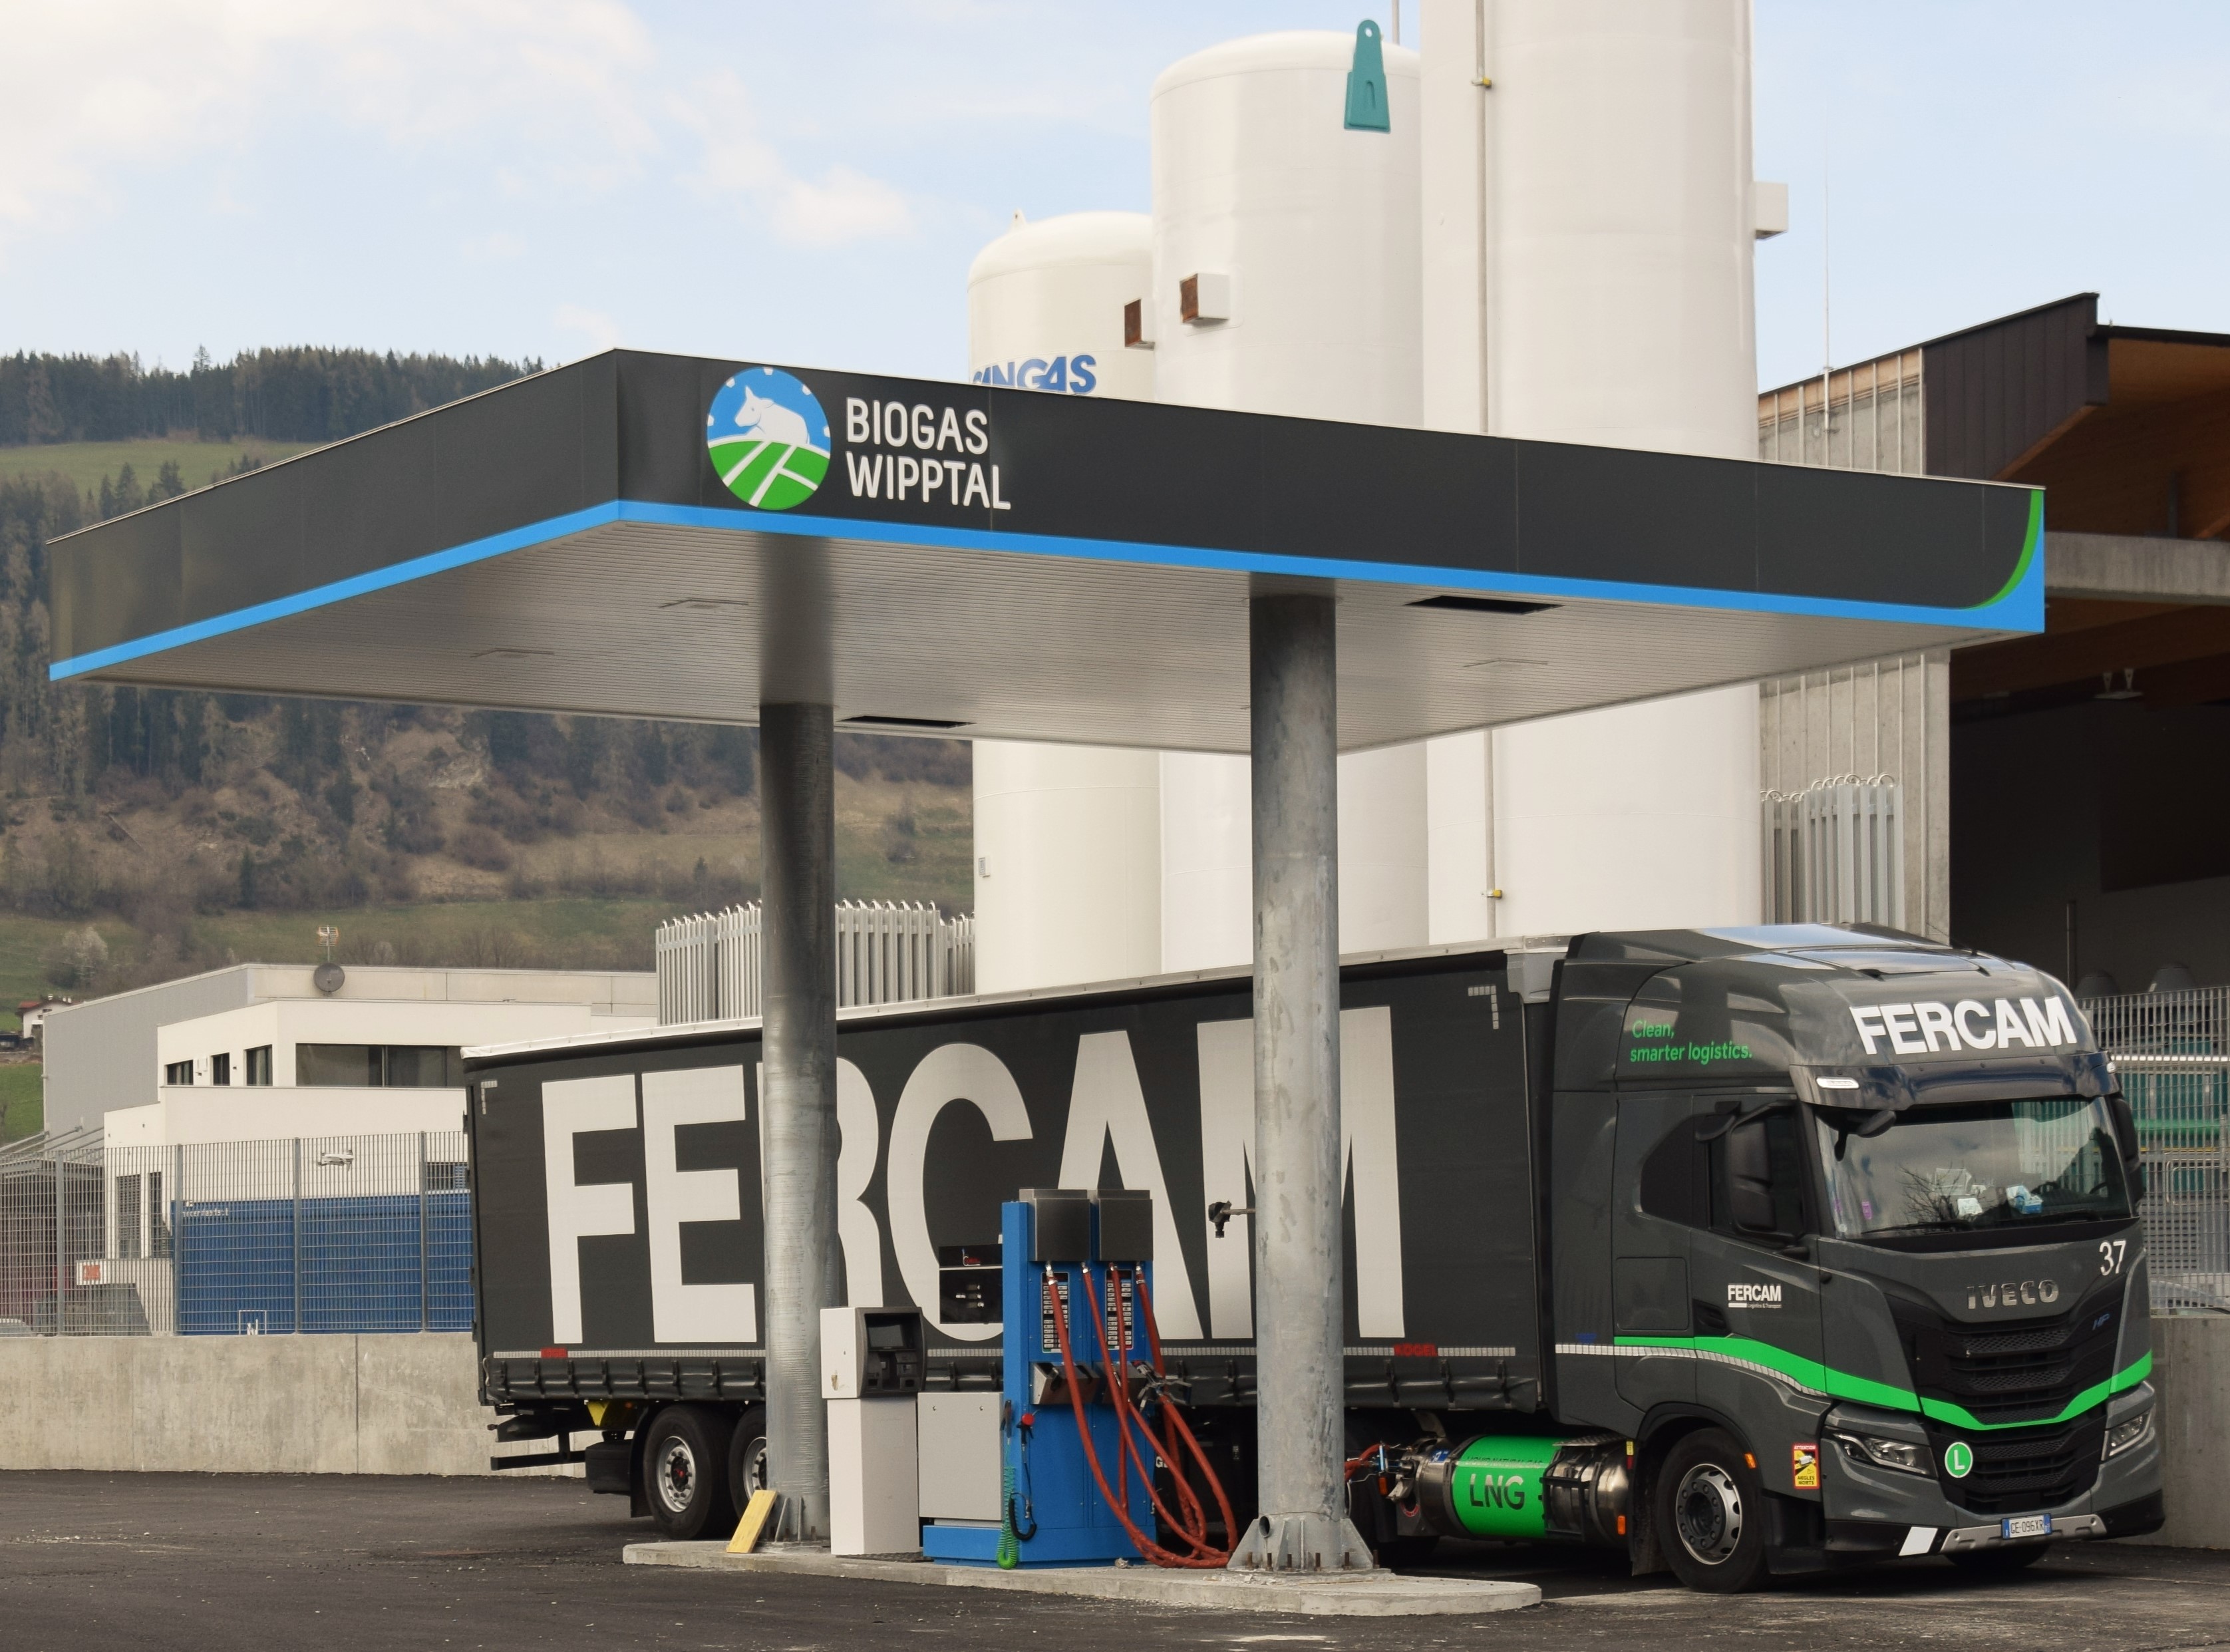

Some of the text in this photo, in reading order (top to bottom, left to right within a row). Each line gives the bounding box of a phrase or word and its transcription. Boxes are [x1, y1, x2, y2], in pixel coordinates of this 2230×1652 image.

[847, 397, 989, 455] BIOGAS
[845, 450, 1011, 510] WIPPTAL
[1632, 1019, 1674, 1039] Clean,
[1849, 995, 2078, 1055] FERCAM
[1630, 1040, 1753, 1065] smarter logistics.
[2099, 1239, 2127, 1276] 37
[1728, 1284, 1782, 1302] FERCAM
[1967, 1279, 2059, 1309] IVECO
[1954, 1450, 1965, 1470] L
[1470, 1473, 1525, 1510] LNG
